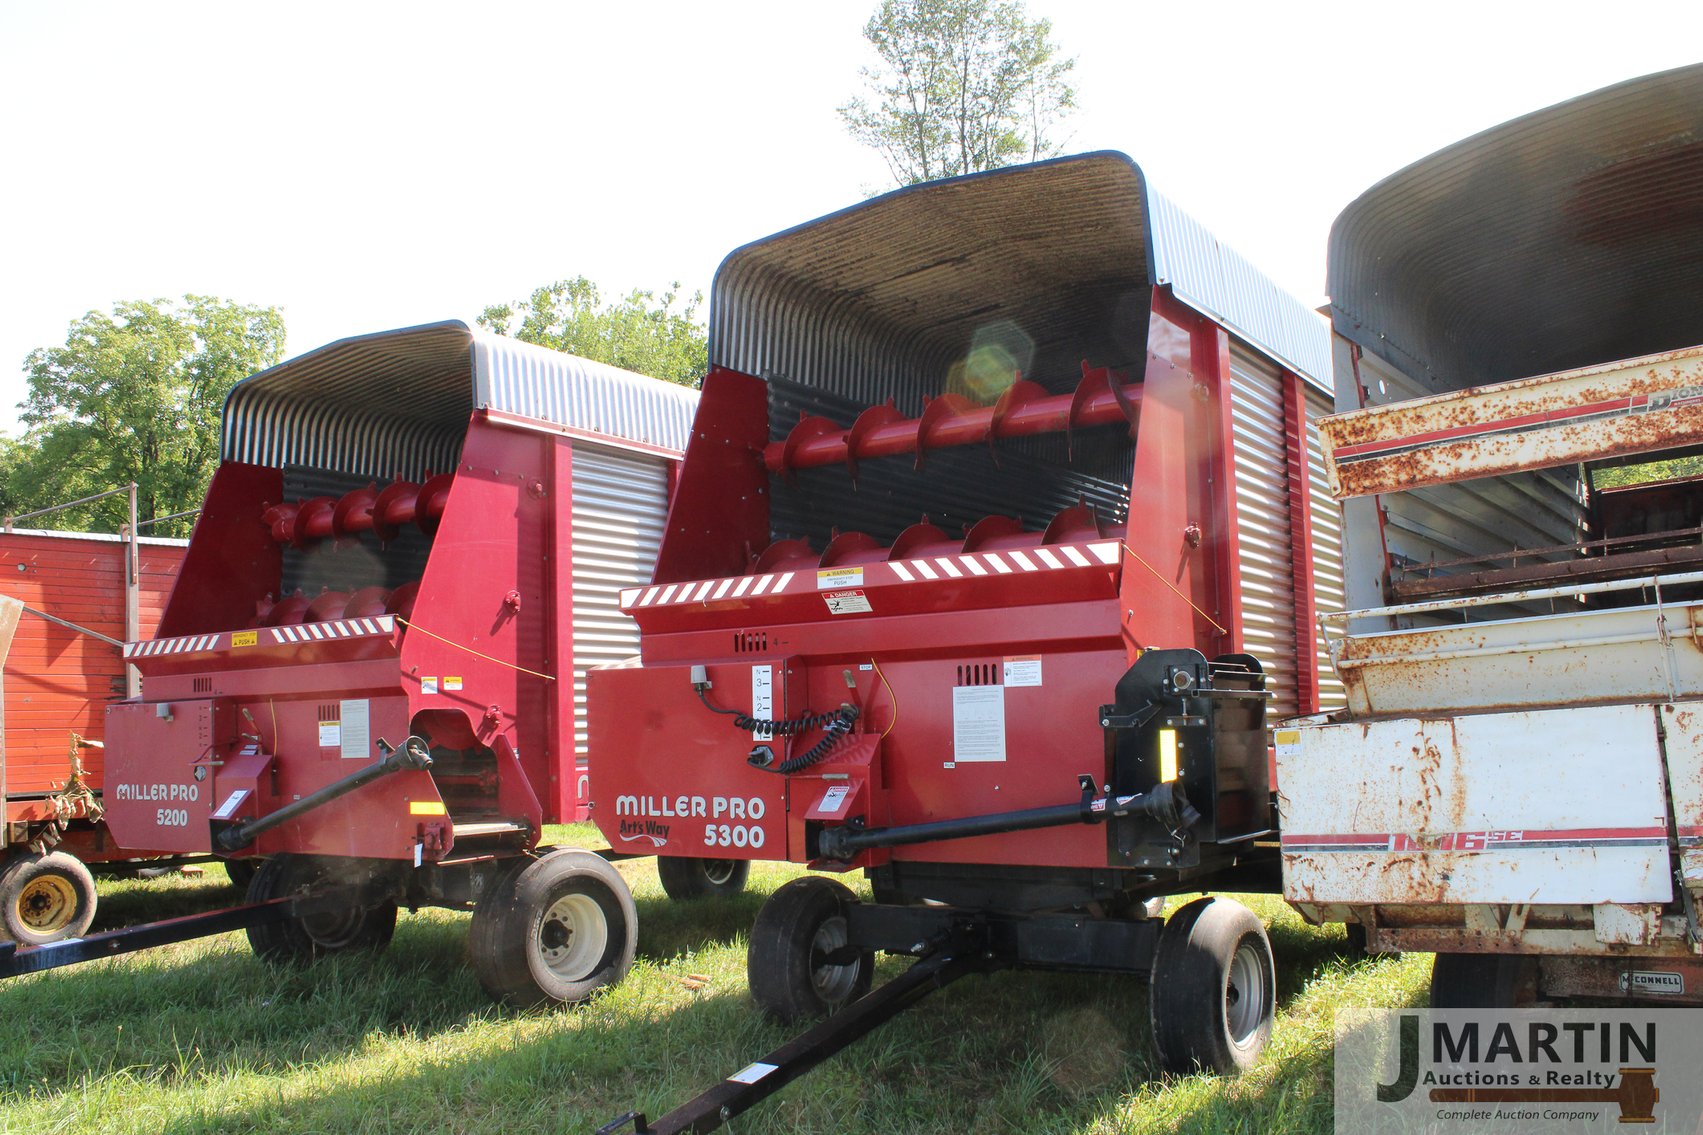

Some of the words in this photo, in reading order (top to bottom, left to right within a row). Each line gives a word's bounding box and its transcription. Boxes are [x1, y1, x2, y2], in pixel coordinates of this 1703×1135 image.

[757, 678, 762, 687] 3
[757, 703, 762, 712] 2
[116, 784, 168, 800] MILLER
[170, 784, 199, 802] PRO
[616, 795, 707, 818] MILLER
[713, 796, 766, 820] PRO
[156, 808, 188, 826] 5200
[620, 819, 644, 834] Art's
[645, 820, 670, 838] Way
[703, 824, 765, 848] 5300
[1622, 975, 1680, 986] MCONNELL
